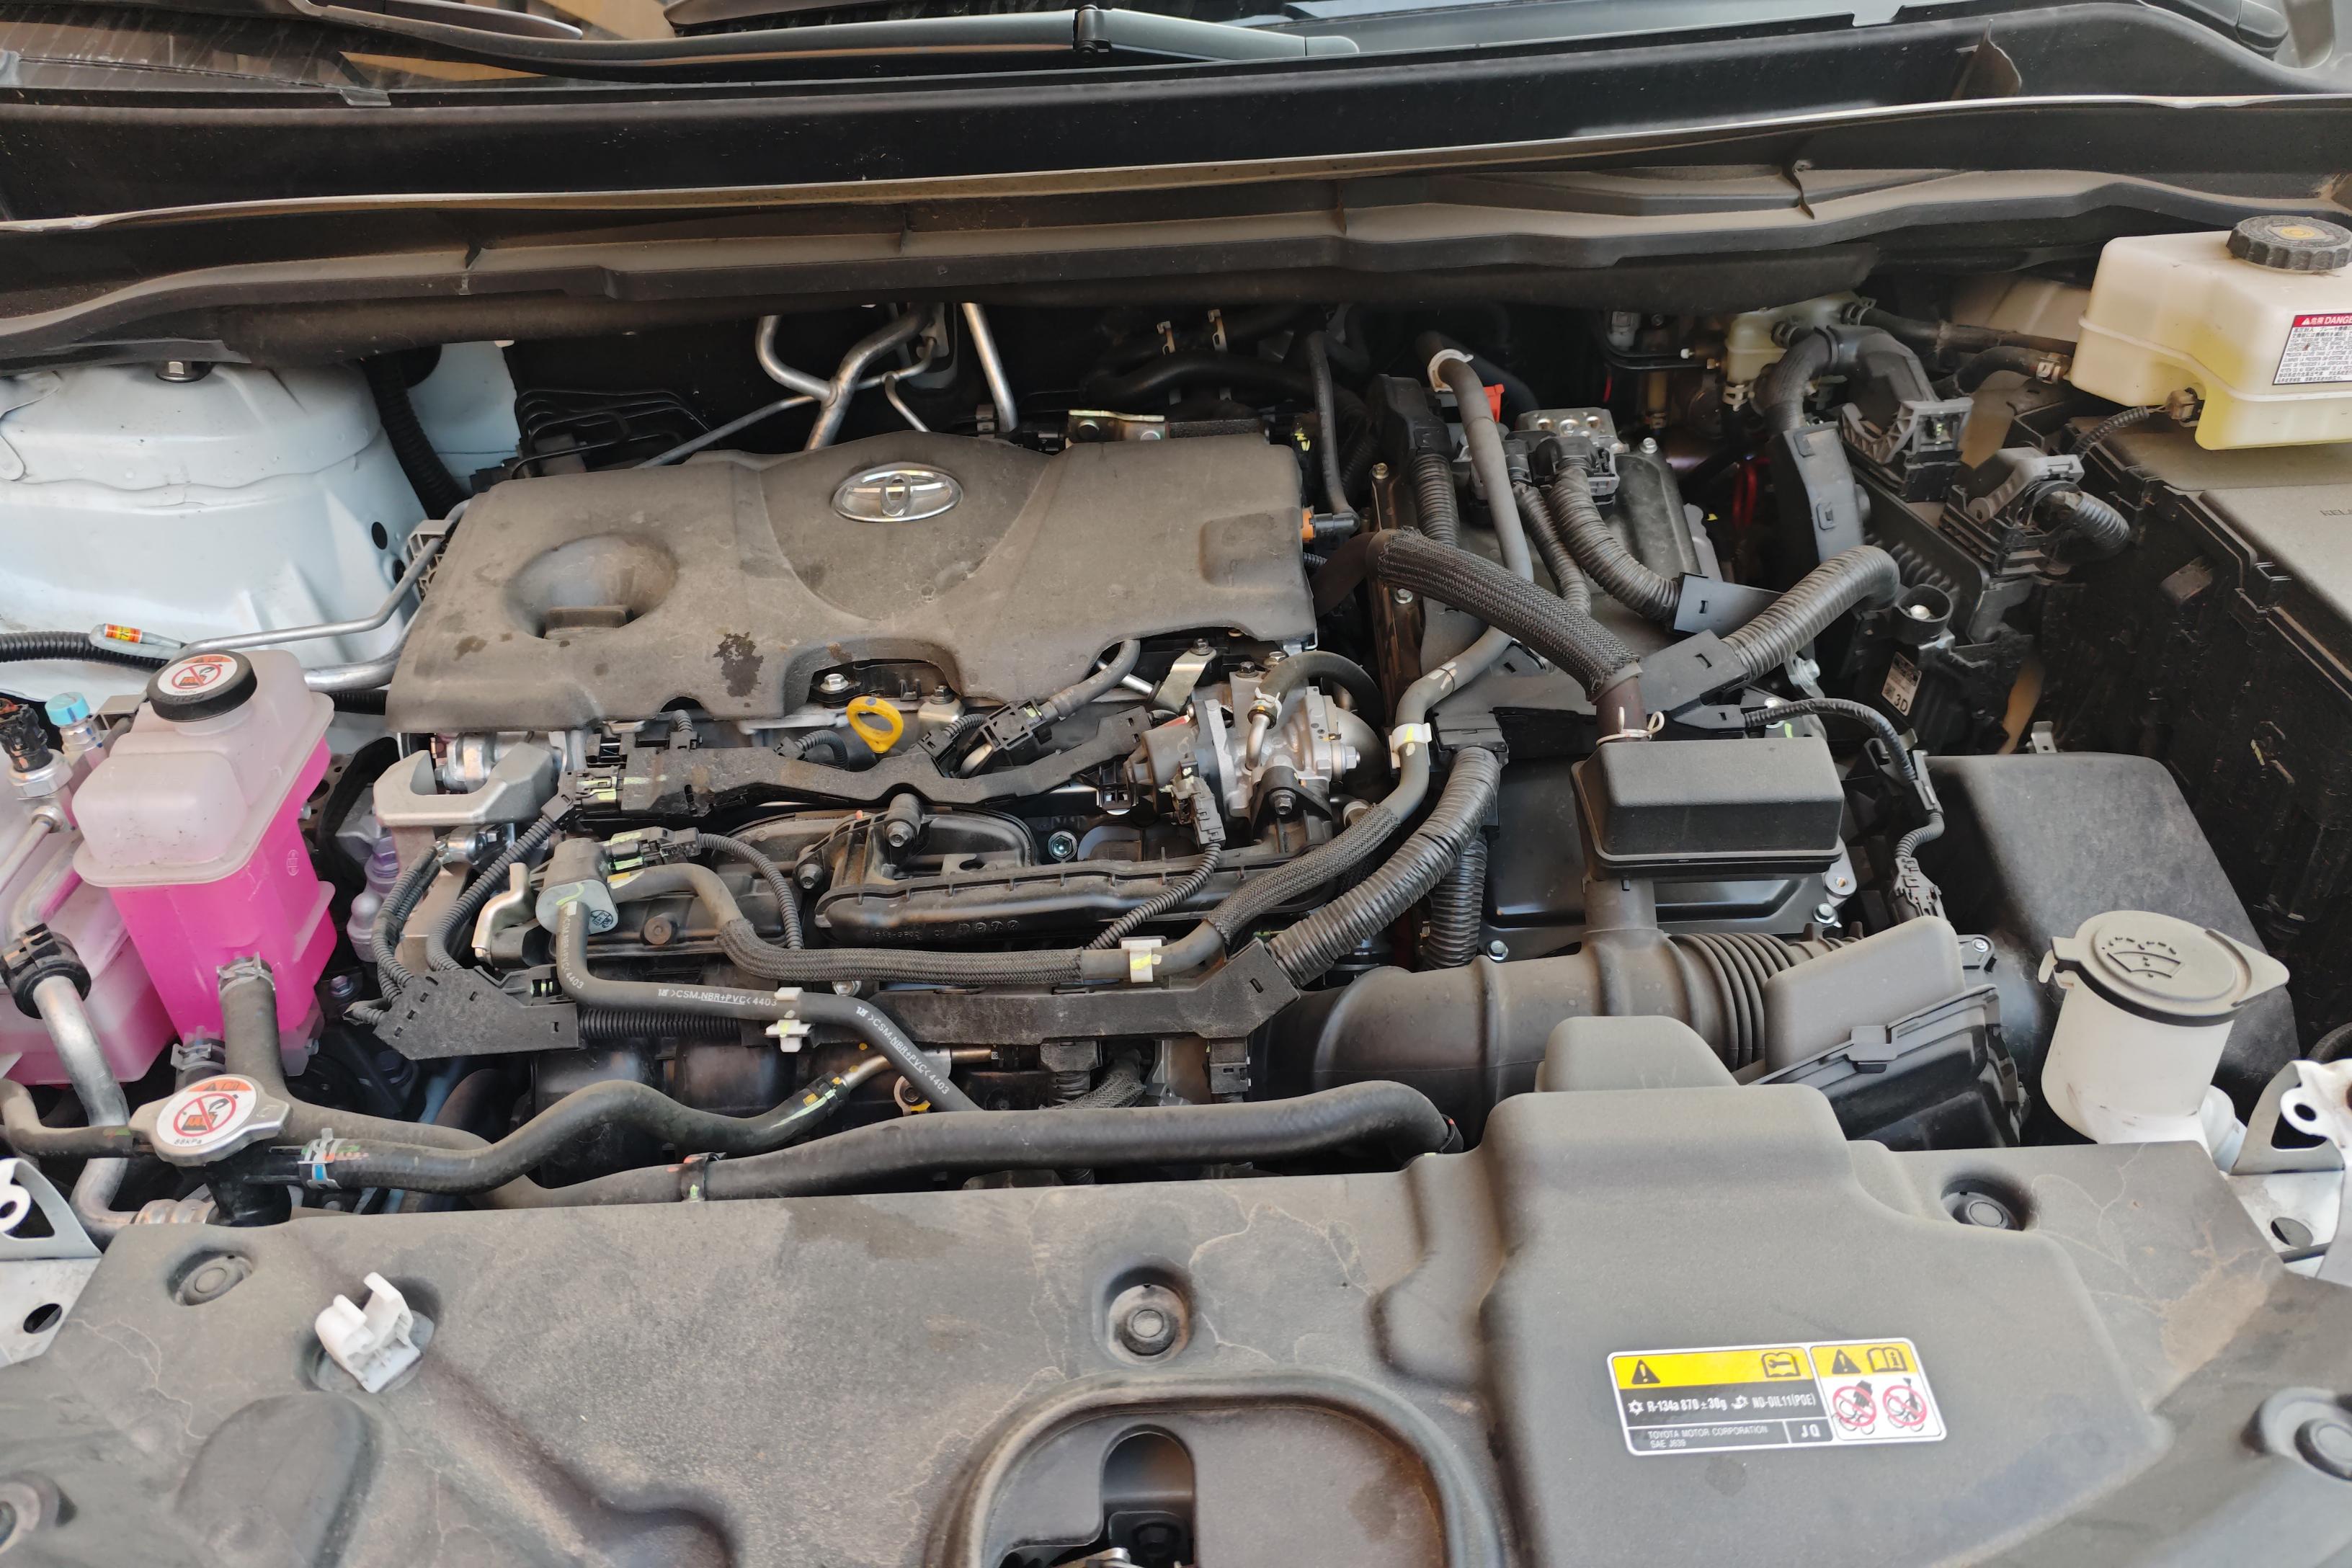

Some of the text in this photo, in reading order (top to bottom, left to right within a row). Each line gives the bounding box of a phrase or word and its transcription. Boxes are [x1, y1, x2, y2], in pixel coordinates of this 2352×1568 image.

[1894, 694, 1908, 712] 3D
[1647, 1400, 1680, 1412] R-134a
[1680, 1399, 1700, 1411] 870
[1647, 1425, 1768, 1439] TOYOTA MOTOR CORPORATION
[1650, 1440, 1667, 1448] SAE
